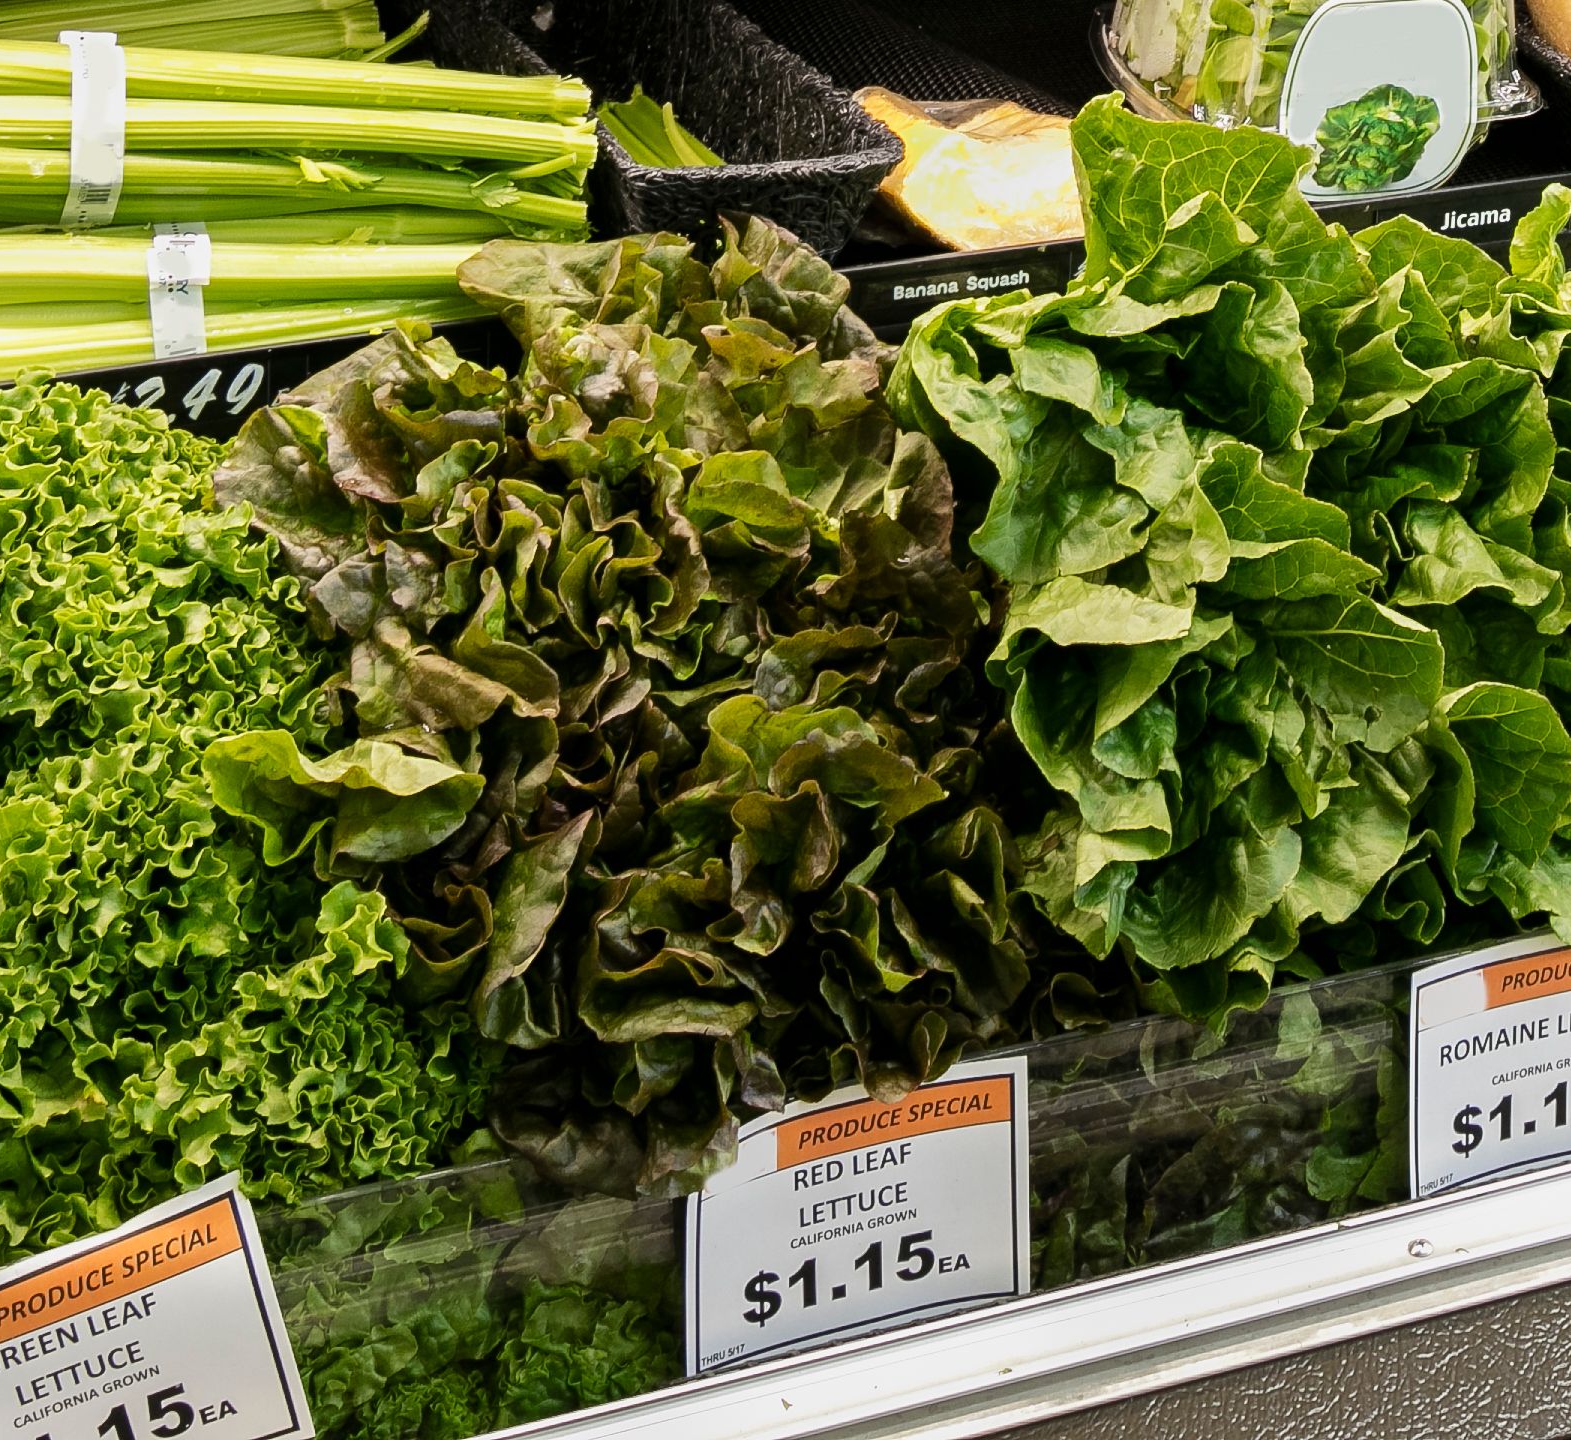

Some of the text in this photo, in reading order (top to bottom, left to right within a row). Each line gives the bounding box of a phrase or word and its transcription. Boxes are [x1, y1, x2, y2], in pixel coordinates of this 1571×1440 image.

[1441, 206, 1512, 230] Jicama
[893, 270, 1030, 301] Banana Squash
[1440, 1018, 1549, 1067] ROMAINE
[1492, 1062, 1553, 1085] CALIFORNIA
[799, 1092, 993, 1149] PRODUCE SPECIAL
[794, 1143, 912, 1191] RED LEAF
[800, 1183, 908, 1227] LETTUCE
[121, 1223, 218, 1279] SPECIAL
[790, 1208, 917, 1249] CALIFORNIA GROWN
[88, 1292, 158, 1338] LEAF
[15, 1340, 145, 1407] LETTUCE
[701, 1343, 745, 1367] THRU 5/17
[14, 1388, 100, 1430] CALIFORNIA
[102, 1364, 161, 1396] GROWN
